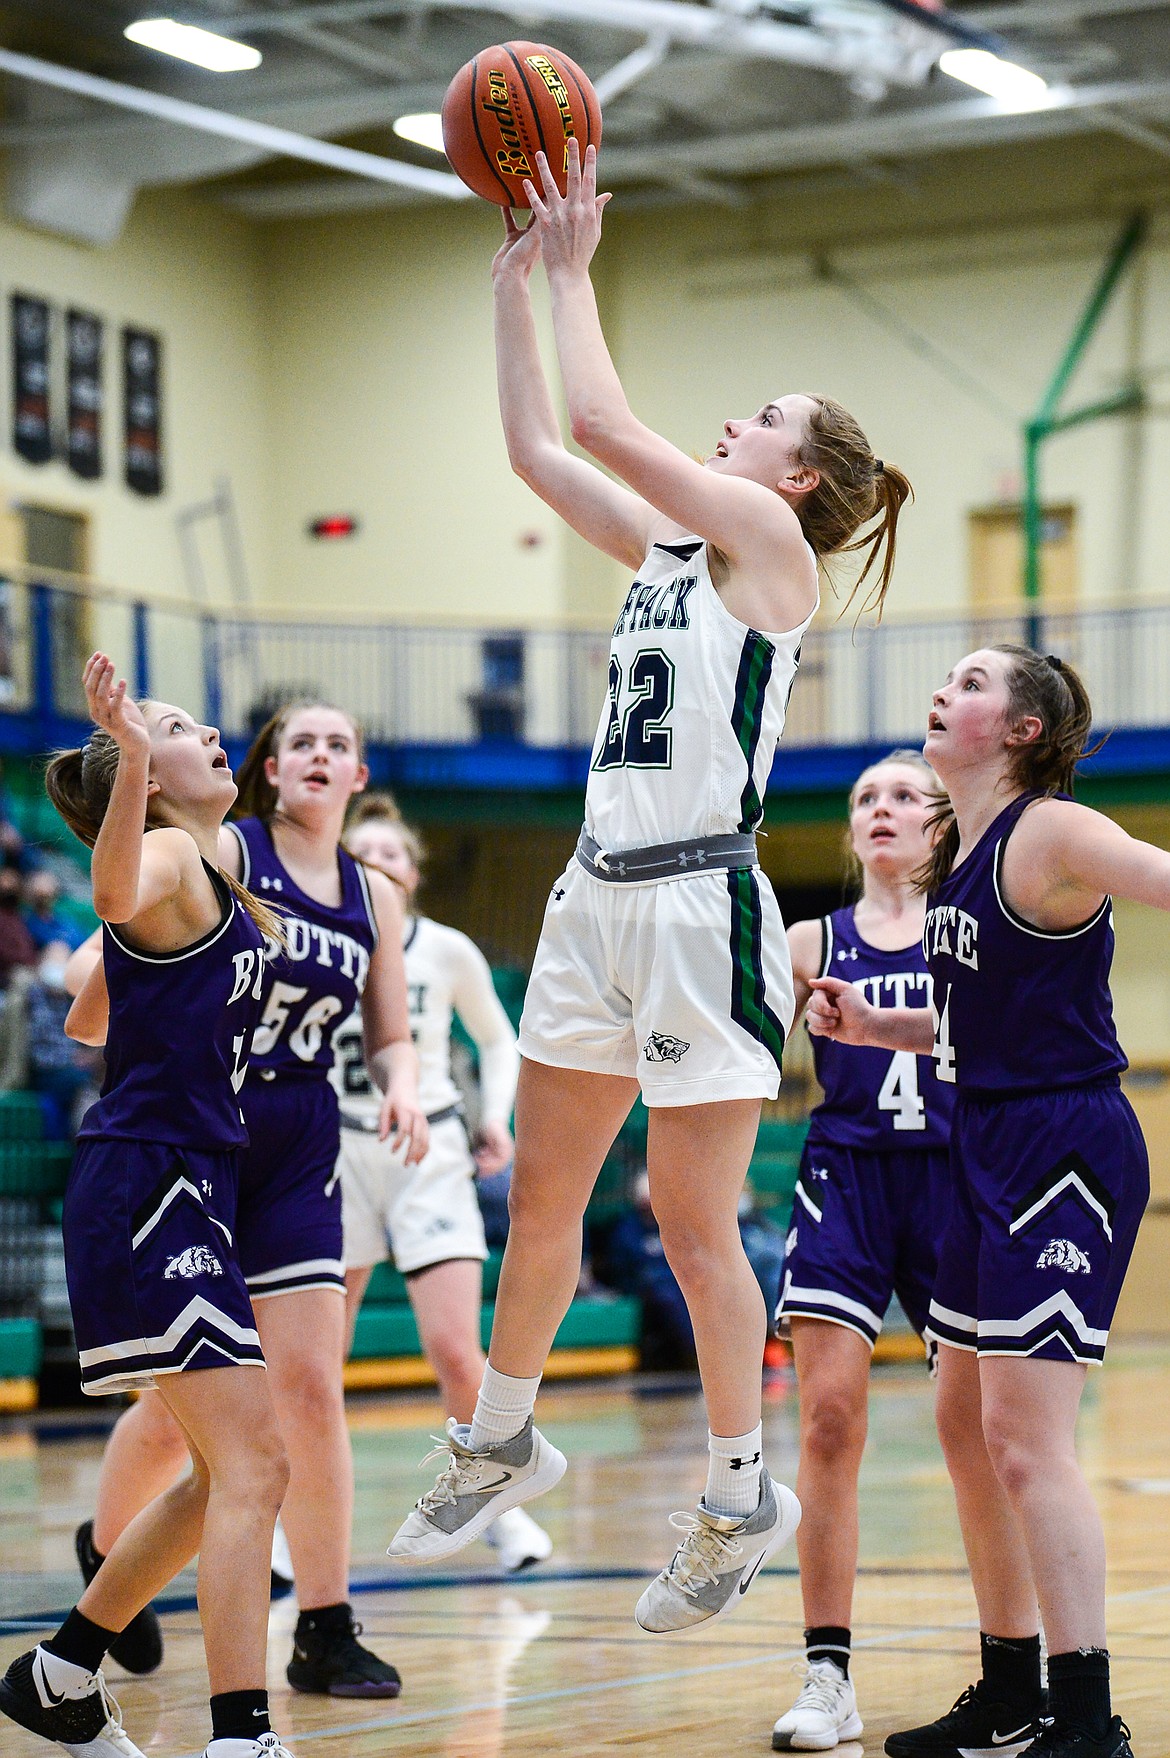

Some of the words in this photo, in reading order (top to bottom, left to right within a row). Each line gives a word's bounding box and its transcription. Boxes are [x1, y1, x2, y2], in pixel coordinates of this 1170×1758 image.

[482, 69, 534, 177] Baden
[591, 648, 676, 772] 22
[877, 1050, 927, 1131] 4
